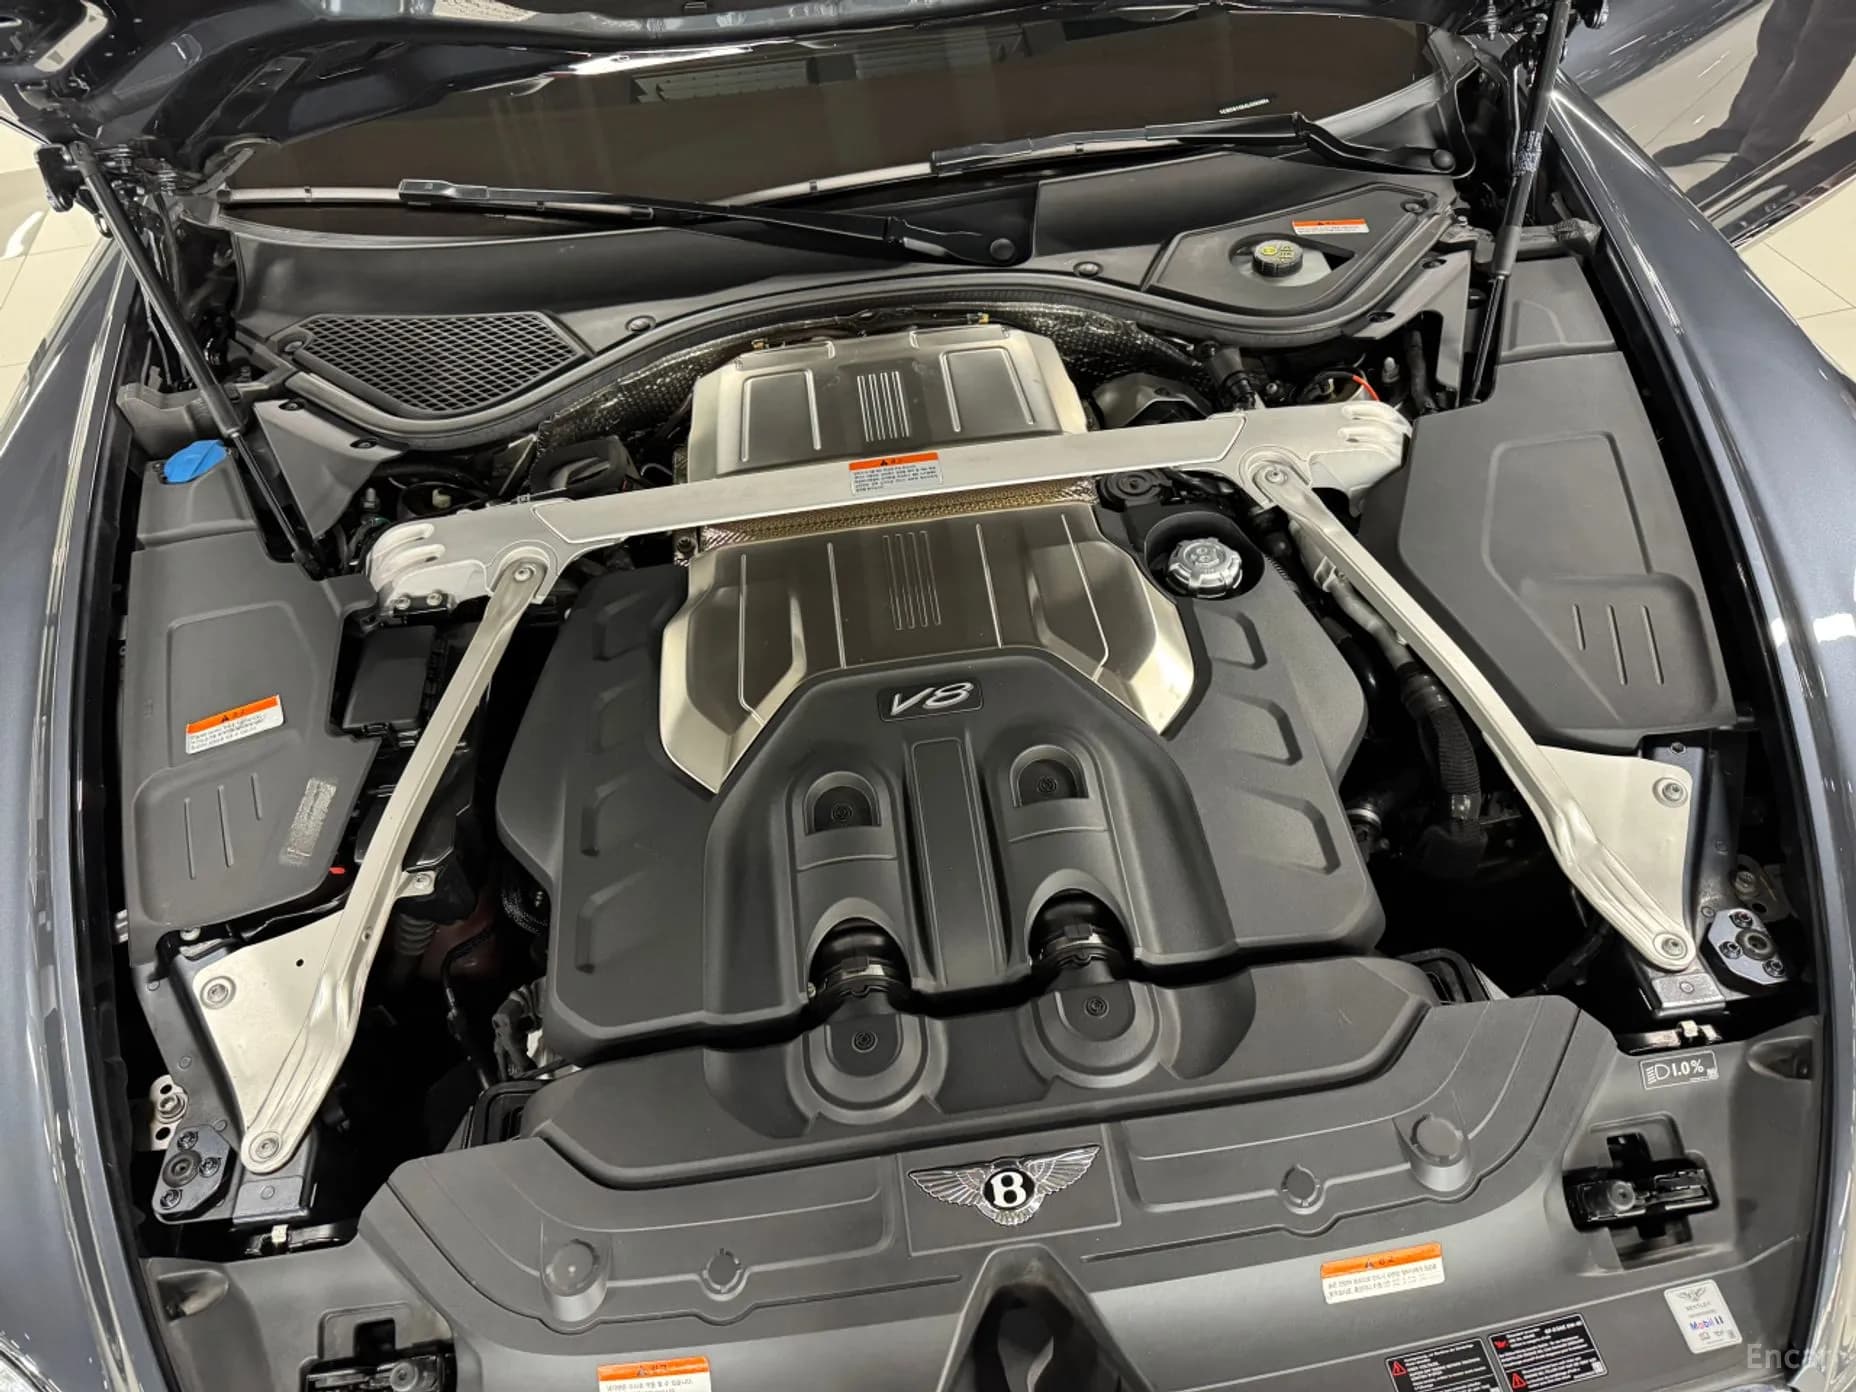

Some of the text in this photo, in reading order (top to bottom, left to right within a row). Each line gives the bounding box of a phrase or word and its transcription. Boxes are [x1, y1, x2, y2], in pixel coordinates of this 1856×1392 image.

[890, 682, 975, 716] V8
[1671, 1059, 1705, 1077] 1.0%
[990, 1171, 1027, 1208] B
